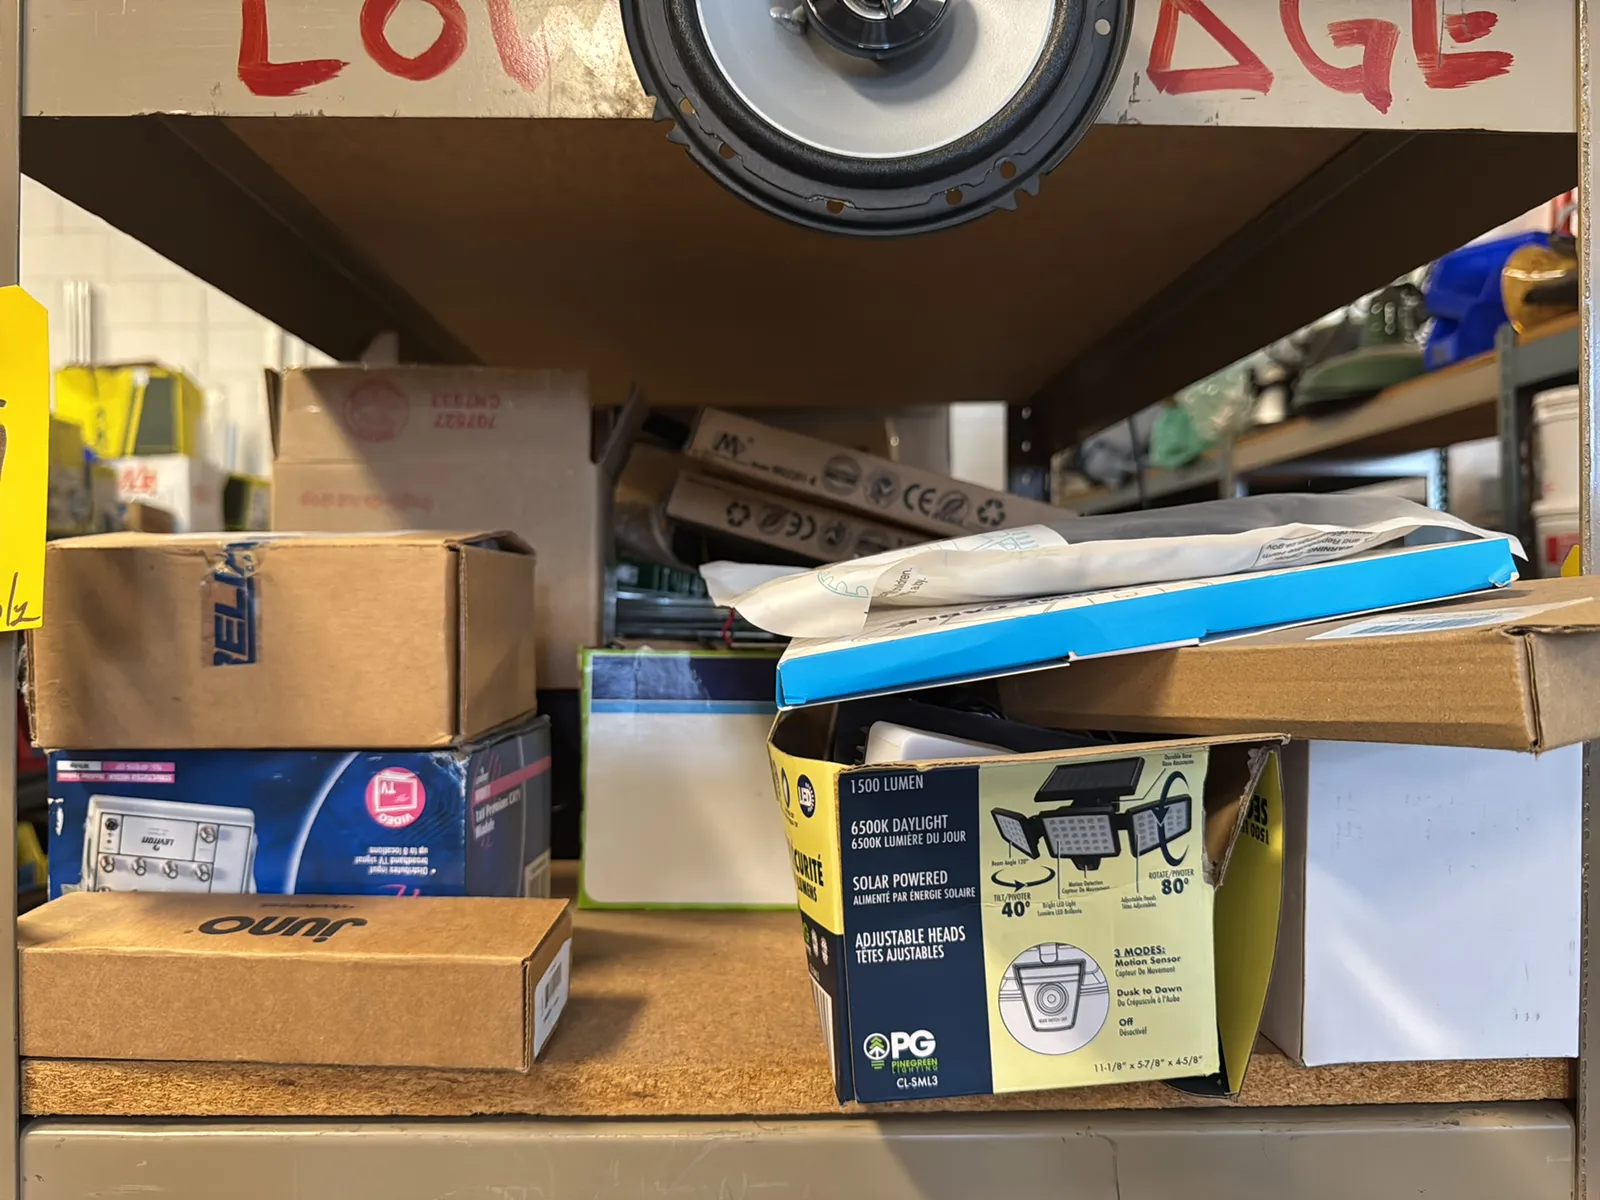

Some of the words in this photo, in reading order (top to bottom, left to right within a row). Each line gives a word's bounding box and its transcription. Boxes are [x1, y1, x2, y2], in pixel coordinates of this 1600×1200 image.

[381, 782, 396, 794] TV
[851, 778, 880, 794] 1500
[884, 774, 924, 792] LUMEN
[379, 813, 414, 825] VIDEO
[851, 819, 889, 835] 6500K
[893, 814, 948, 833] DAYLIGHT
[851, 836, 881, 850] 6500K
[884, 831, 923, 847] LUMIÈRE
[926, 833, 939, 844] DU
[942, 830, 966, 843] JOUR
[1250, 826, 1270, 845] 1500
[792, 847, 824, 887] CURITÉ
[1149, 868, 1195, 880] ROTATE/PIVOTER
[852, 874, 889, 891] SOLAR
[893, 870, 948, 888] POWERED
[1161, 877, 1189, 895] 80°
[853, 891, 890, 906] ALIMENTÉ
[892, 892, 908, 902] PAR
[910, 889, 942, 901] ÉNERGIE
[944, 887, 976, 899] SOLAIRE
[994, 892, 1031, 903] TILT/PIVOTER
[1002, 901, 1030, 918] 40°
[198, 915, 368, 943] juno
[855, 928, 925, 948] ADJUSTABLE
[928, 925, 966, 943] HEADS
[855, 947, 883, 964] TÊTES
[886, 944, 945, 962] AJUSTABLES
[1114, 948, 1121, 958] 3
[1124, 945, 1166, 957] MODES:
[1115, 957, 1147, 967] Motion
[1150, 955, 1181, 965] Sensor
[1115, 968, 1136, 977] Capteur
[1138, 967, 1145, 975] De
[1117, 987, 1140, 997] Dusk
[1142, 986, 1152, 994] to
[1155, 985, 1183, 994] Dawn
[1117, 998, 1126, 1006] Du
[1119, 1017, 1134, 1026] Off
[890, 1029, 936, 1059] PG
[891, 1058, 938, 1068] PINEGREEN
[892, 1066, 938, 1074] LIGHTING
[1094, 1061, 1127, 1072] 11-1/8"
[1137, 1058, 1165, 1070] 5-7/8"
[1175, 1055, 1203, 1066] 4-5/8"
[896, 1075, 938, 1089] CL-SML3
